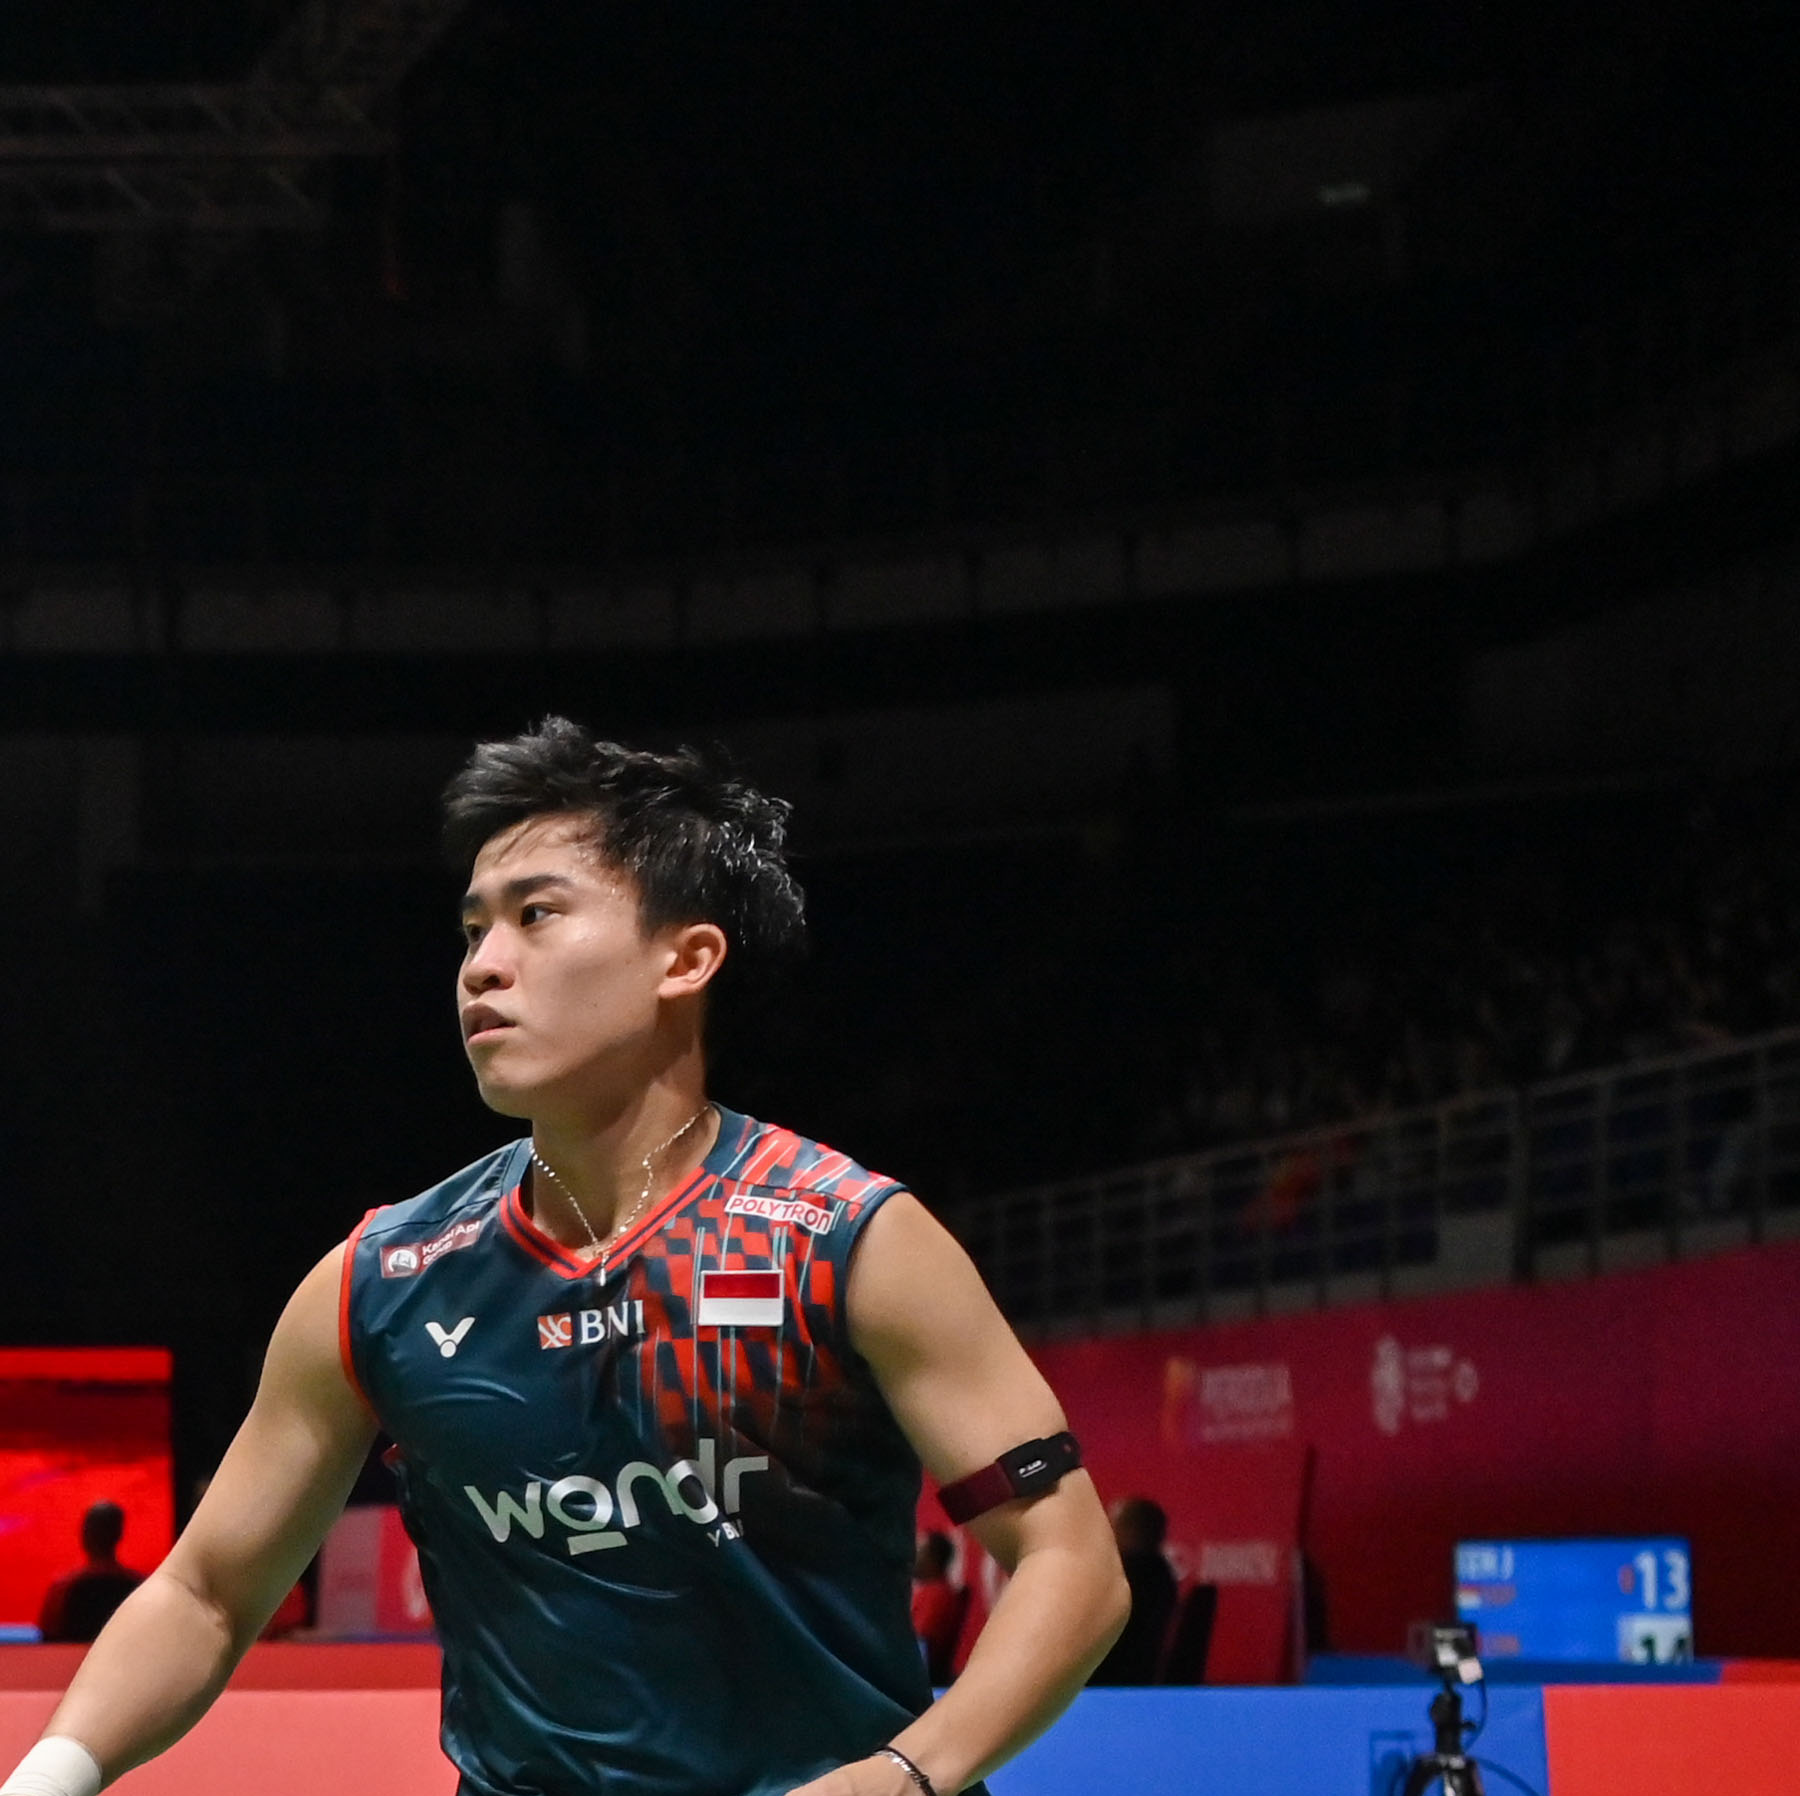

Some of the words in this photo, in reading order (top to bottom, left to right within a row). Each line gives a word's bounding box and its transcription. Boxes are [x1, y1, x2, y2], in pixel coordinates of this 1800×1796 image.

[729, 1197, 830, 1231] POLYTRON
[580, 1299, 645, 1344] BNI
[463, 1438, 769, 1556] wondr
[1634, 1550, 1689, 1610] 13
